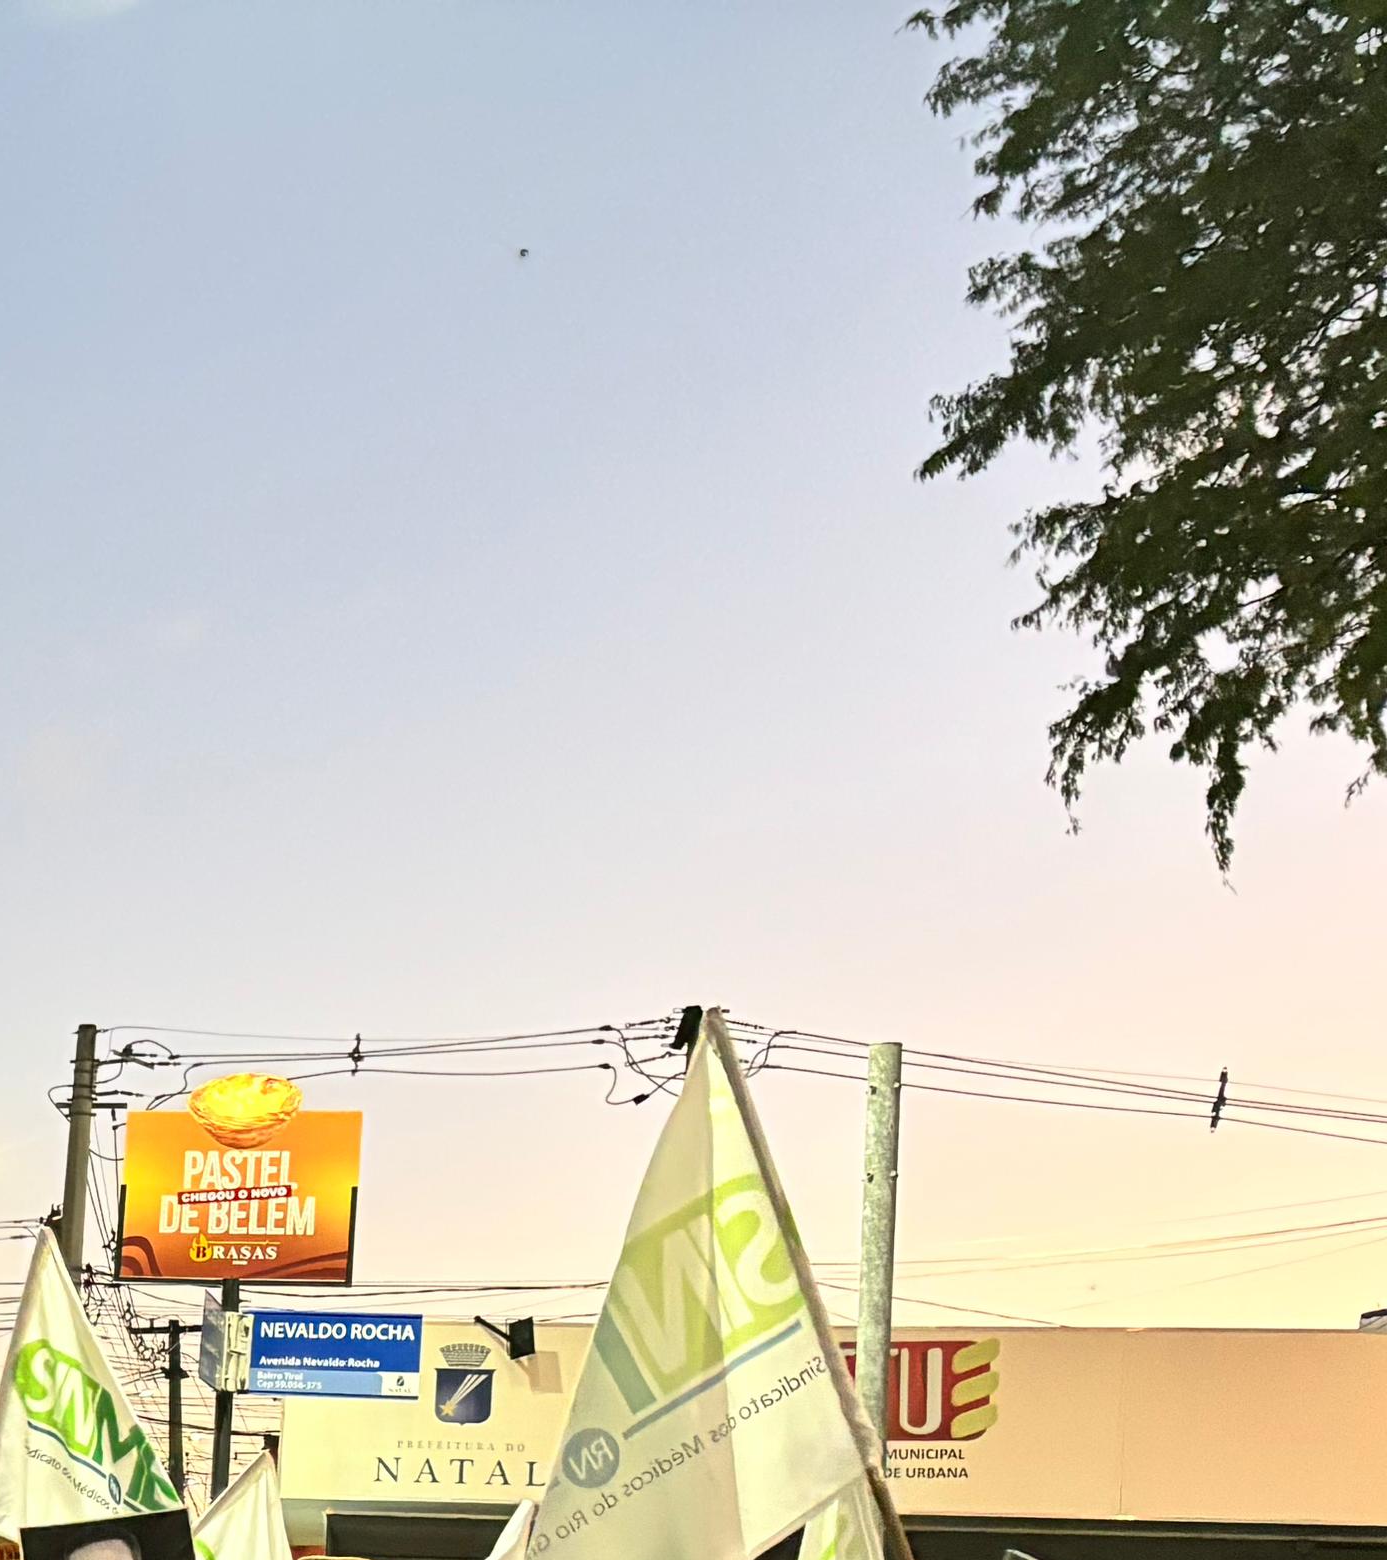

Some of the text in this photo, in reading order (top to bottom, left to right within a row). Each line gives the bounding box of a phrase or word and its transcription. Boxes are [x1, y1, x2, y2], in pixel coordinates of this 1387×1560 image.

[183, 1151, 298, 1190] PASTEL
[181, 1187, 288, 1204] CHEGOU O NOVO
[158, 1195, 316, 1236] DE BELEM
[194, 1244, 278, 1260] BRASAS
[260, 1321, 415, 1341] NEVALDO ROCHA
[259, 1356, 380, 1369] Avenida Nevaldo Rocha
[397, 1440, 525, 1452] PREFEITURA DO
[886, 1448, 966, 1460] MUNICIPAL
[373, 1457, 546, 1487] NATAL
[906, 1467, 969, 1479] URBANA
